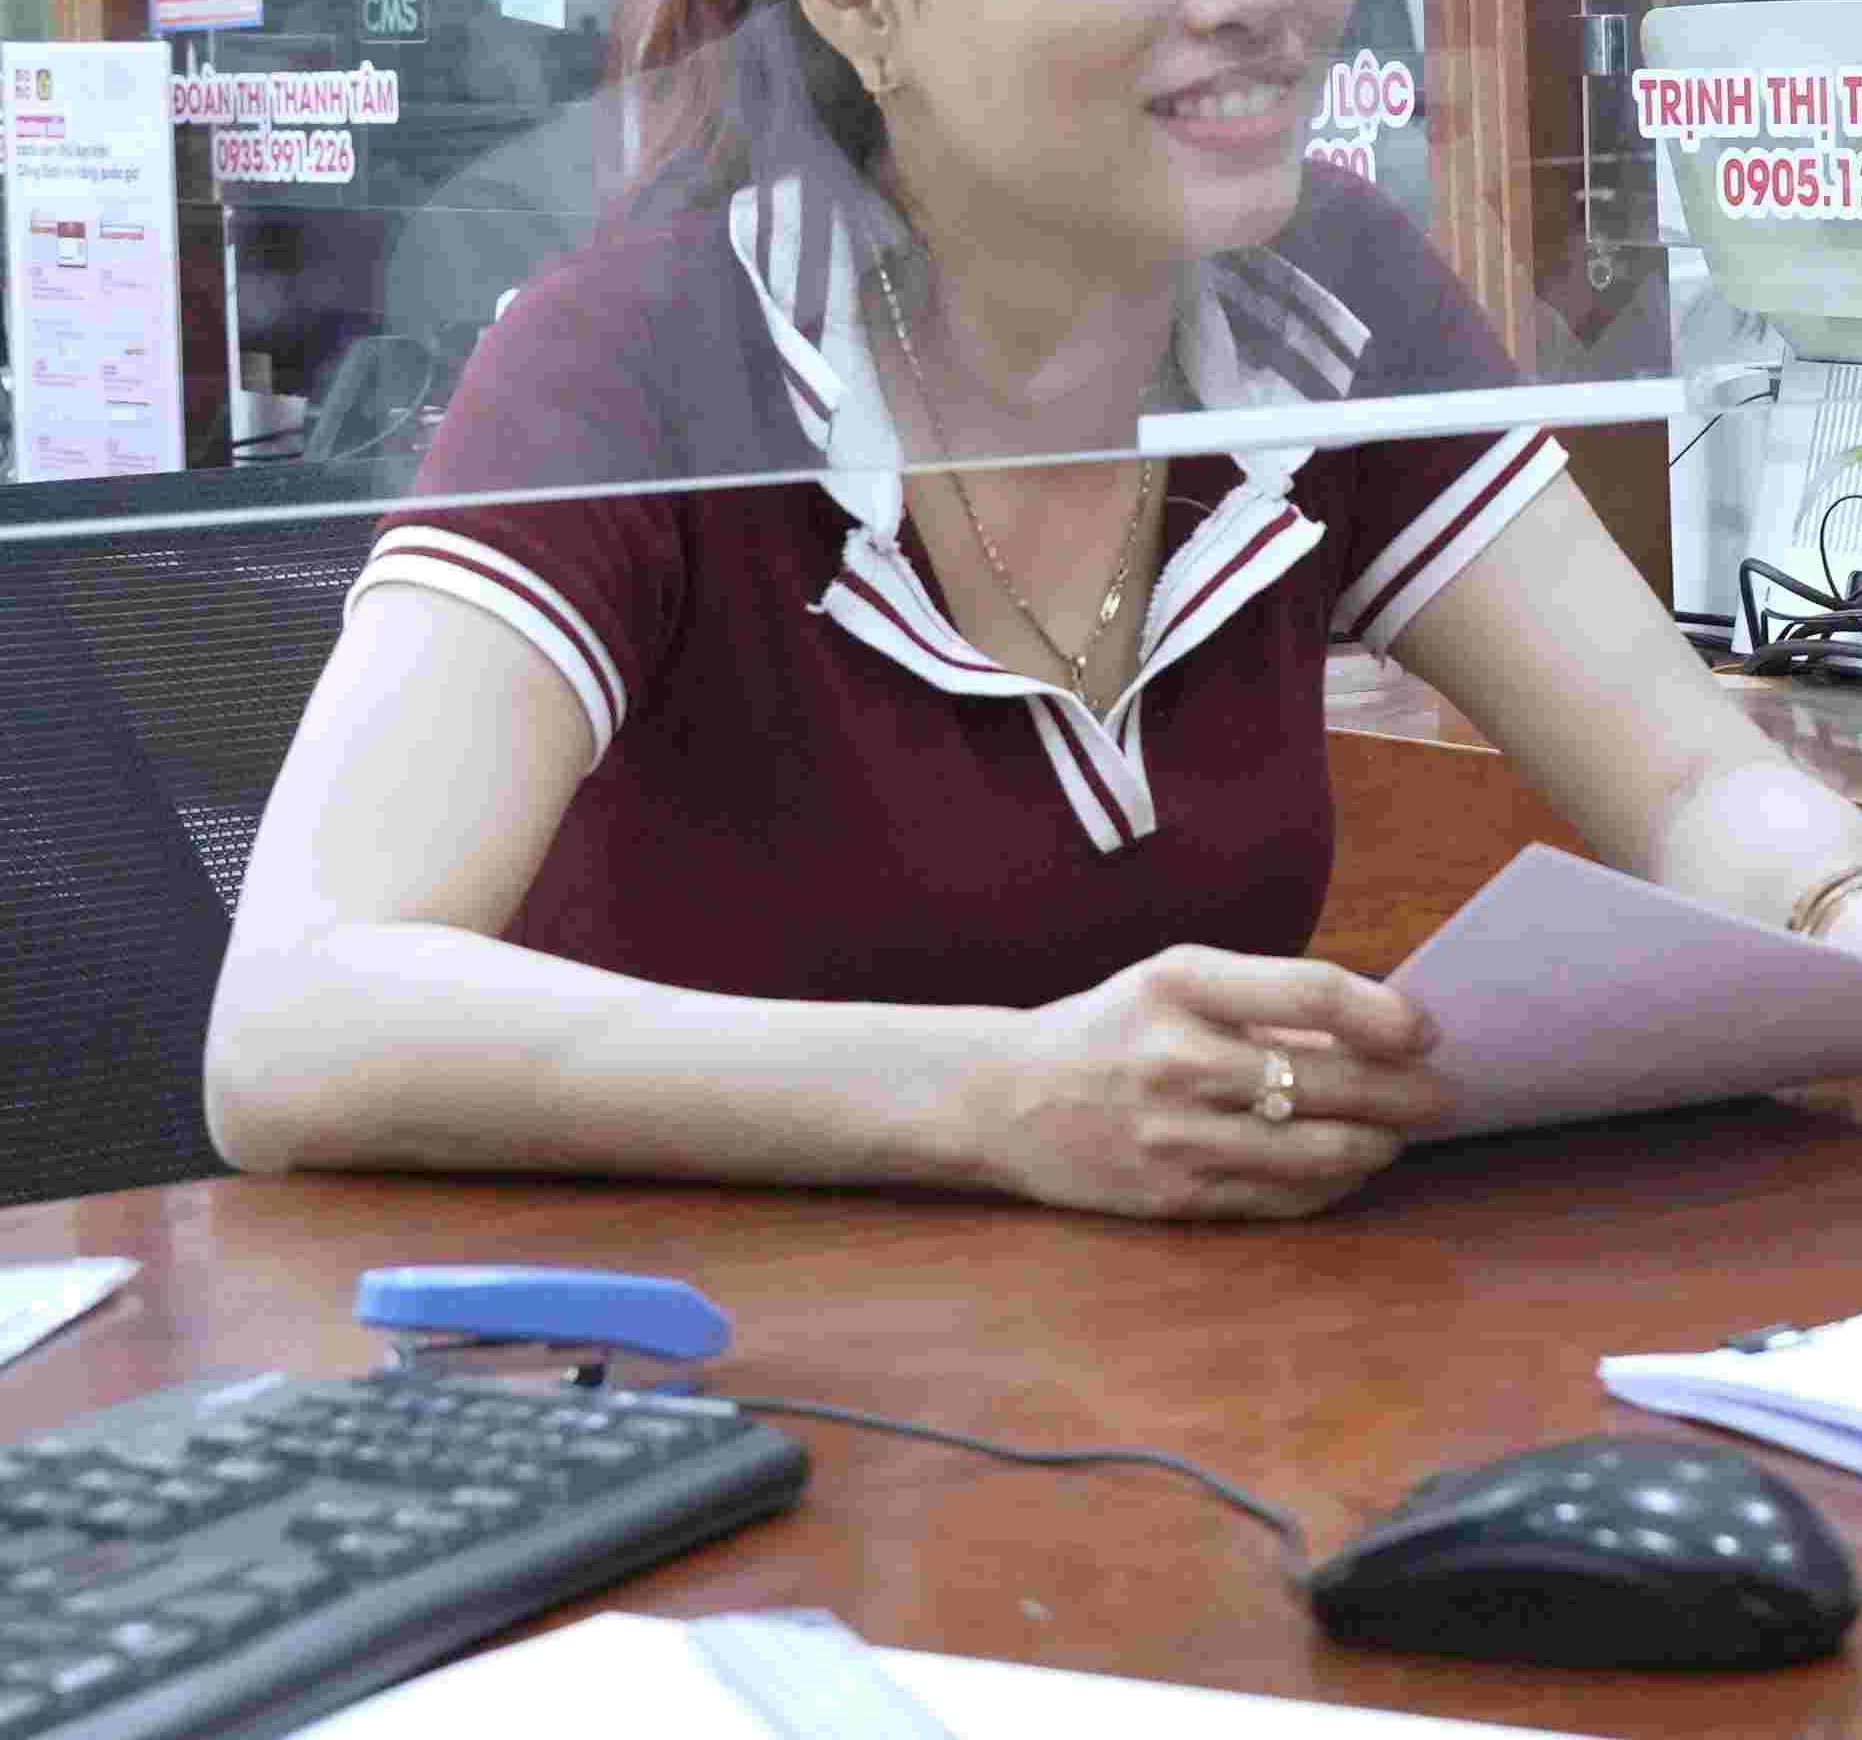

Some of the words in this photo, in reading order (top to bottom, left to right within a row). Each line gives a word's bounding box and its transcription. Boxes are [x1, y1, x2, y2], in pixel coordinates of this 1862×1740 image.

[272, 80, 344, 116] THANH
[350, 66, 395, 116] TÂM
[1639, 74, 1753, 140] TRỊNH
[1766, 74, 1829, 141] THỊ
